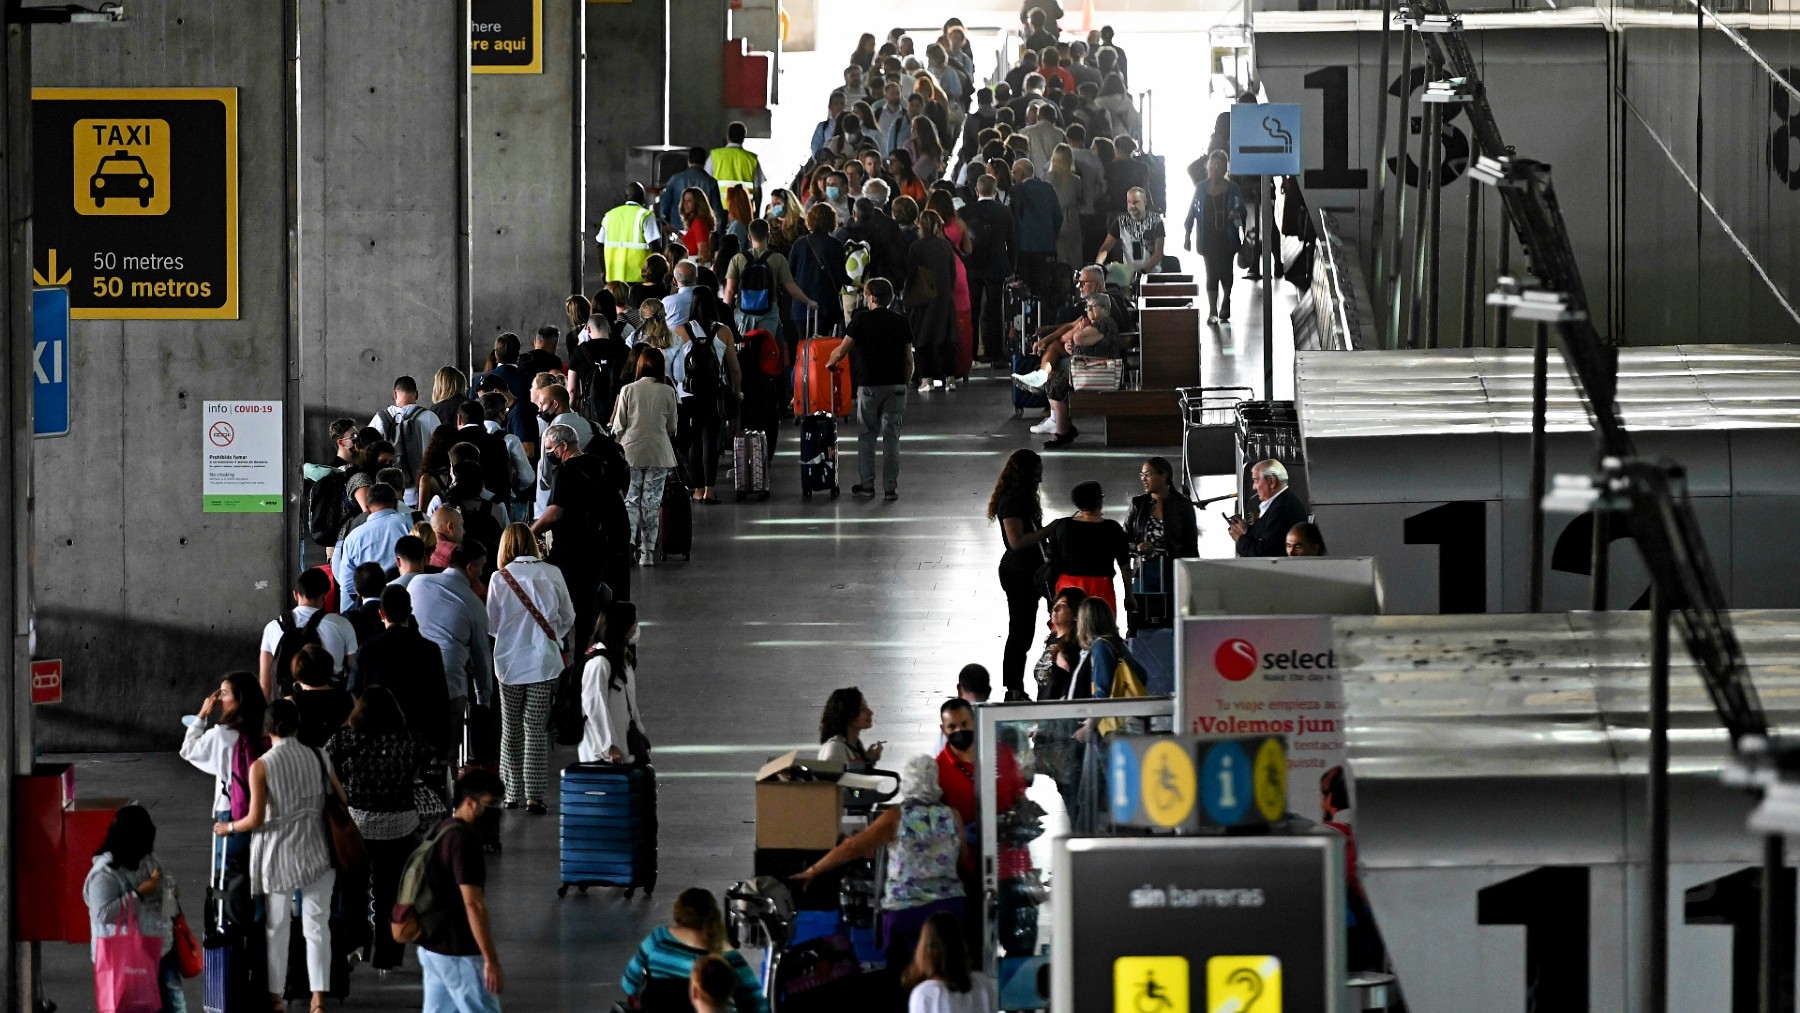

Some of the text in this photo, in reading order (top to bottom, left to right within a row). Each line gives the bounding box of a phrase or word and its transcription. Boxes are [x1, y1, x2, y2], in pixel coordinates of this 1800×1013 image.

[470, 39, 490, 50] re
[92, 125, 151, 146] TAXI
[1304, 65, 1469, 189] 13
[93, 252, 184, 270] 50 metres
[93, 276, 211, 297] 50 metros
[208, 403, 228, 413] info
[1234, 700, 1265, 713] viaje
[1130, 883, 1166, 908] sin
[1477, 866, 1797, 1013] 11
